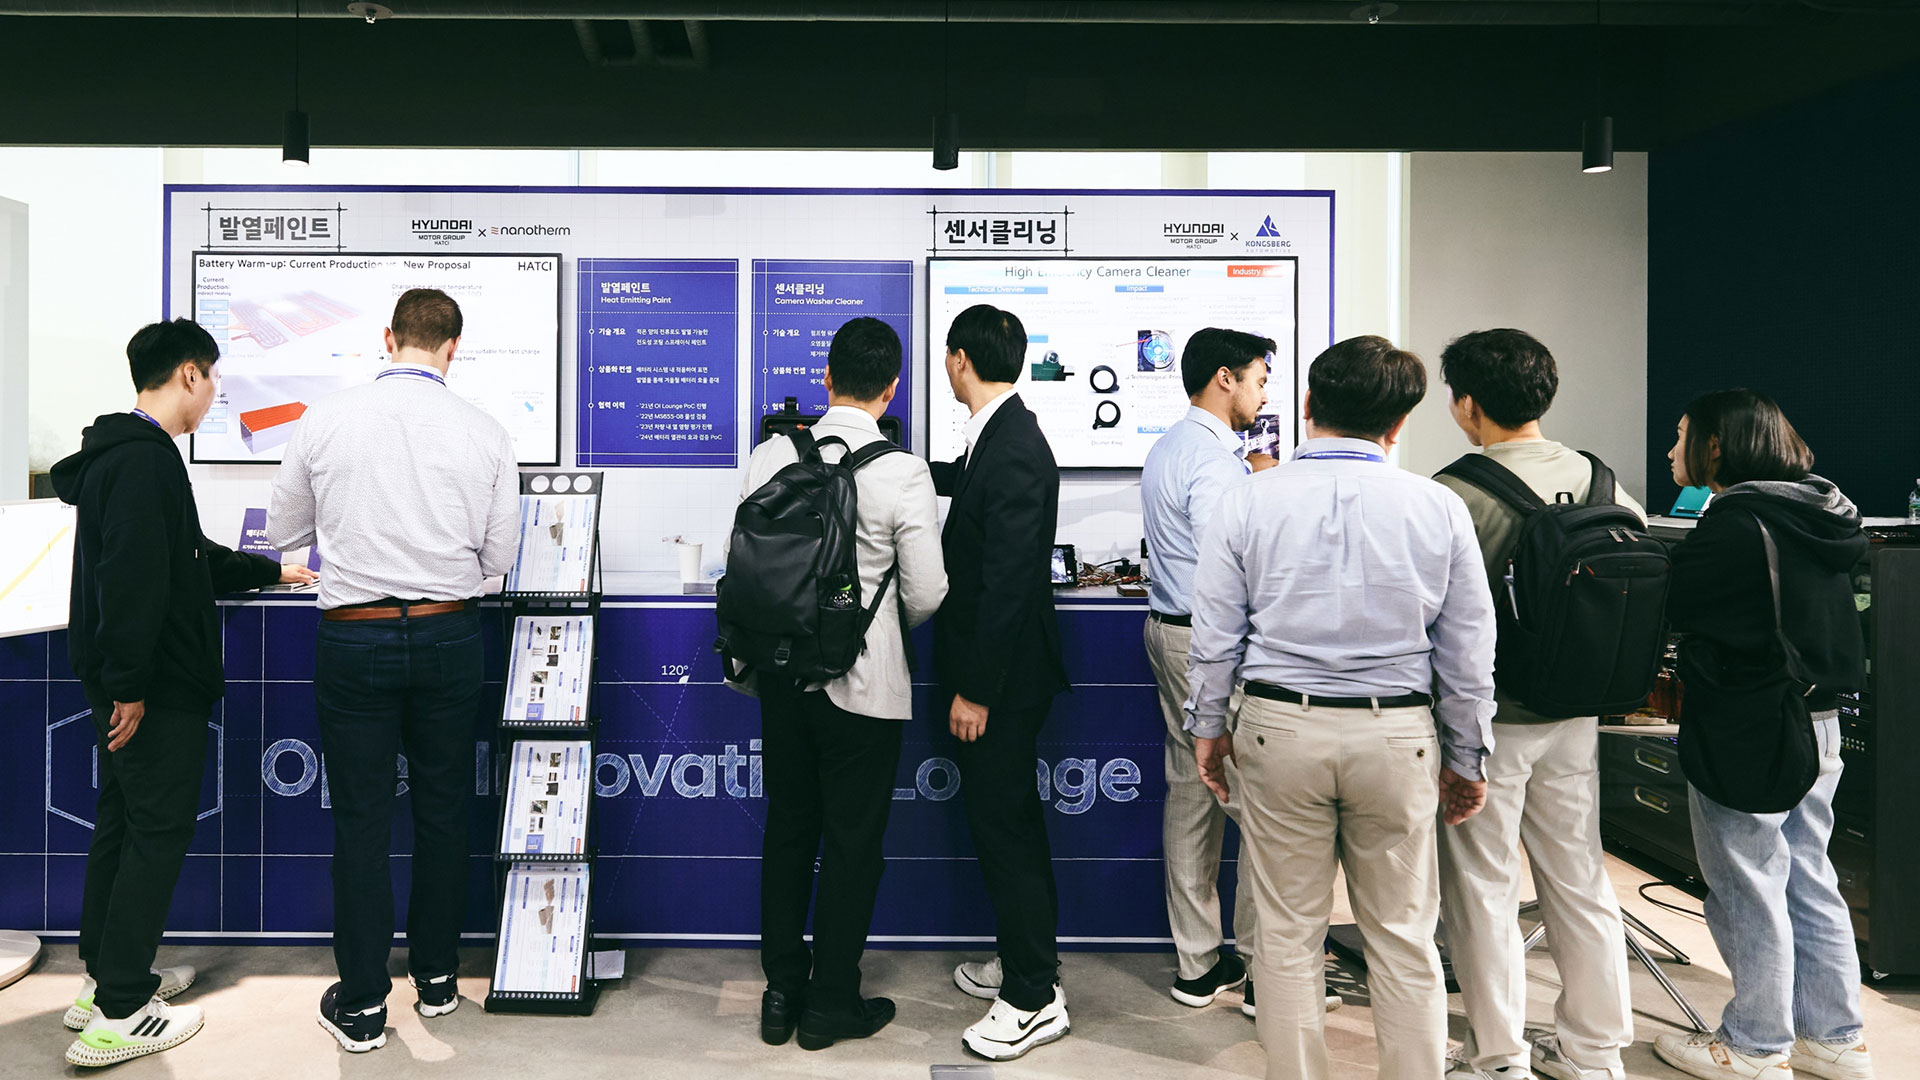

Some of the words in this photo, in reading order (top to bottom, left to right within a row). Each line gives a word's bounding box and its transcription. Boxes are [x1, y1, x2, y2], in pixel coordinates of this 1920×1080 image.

[219, 215, 331, 241] 발열페인트
[412, 220, 472, 230] HYUNDAI
[501, 225, 570, 235] nanotherm
[1164, 224, 1224, 233] HYUNDAI
[944, 219, 1056, 245] 센서클리닝
[199, 259, 235, 270] Battery
[238, 260, 286, 270] Warm-up:
[289, 260, 326, 269] Current
[404, 261, 425, 269] New
[428, 261, 471, 271] Proposal
[518, 262, 552, 271] HATCI
[1005, 266, 1033, 280] High
[1097, 266, 1142, 277] Camera
[1146, 266, 1191, 277] Cleaner
[1233, 268, 1261, 276] Industry
[601, 282, 651, 294] 발열페인트
[775, 283, 825, 295] 센서클리닝
[600, 296, 619, 304] Heat
[620, 296, 651, 305] Emitting
[775, 297, 805, 305] Camera
[598, 328, 612, 336] 기술
[612, 328, 626, 336] 개요
[772, 329, 786, 337] 기술
[787, 329, 800, 337] 개요
[772, 366, 792, 375] 상품화
[792, 366, 806, 375] 컨셉
[598, 401, 612, 409] 협력
[612, 401, 625, 409] 이력
